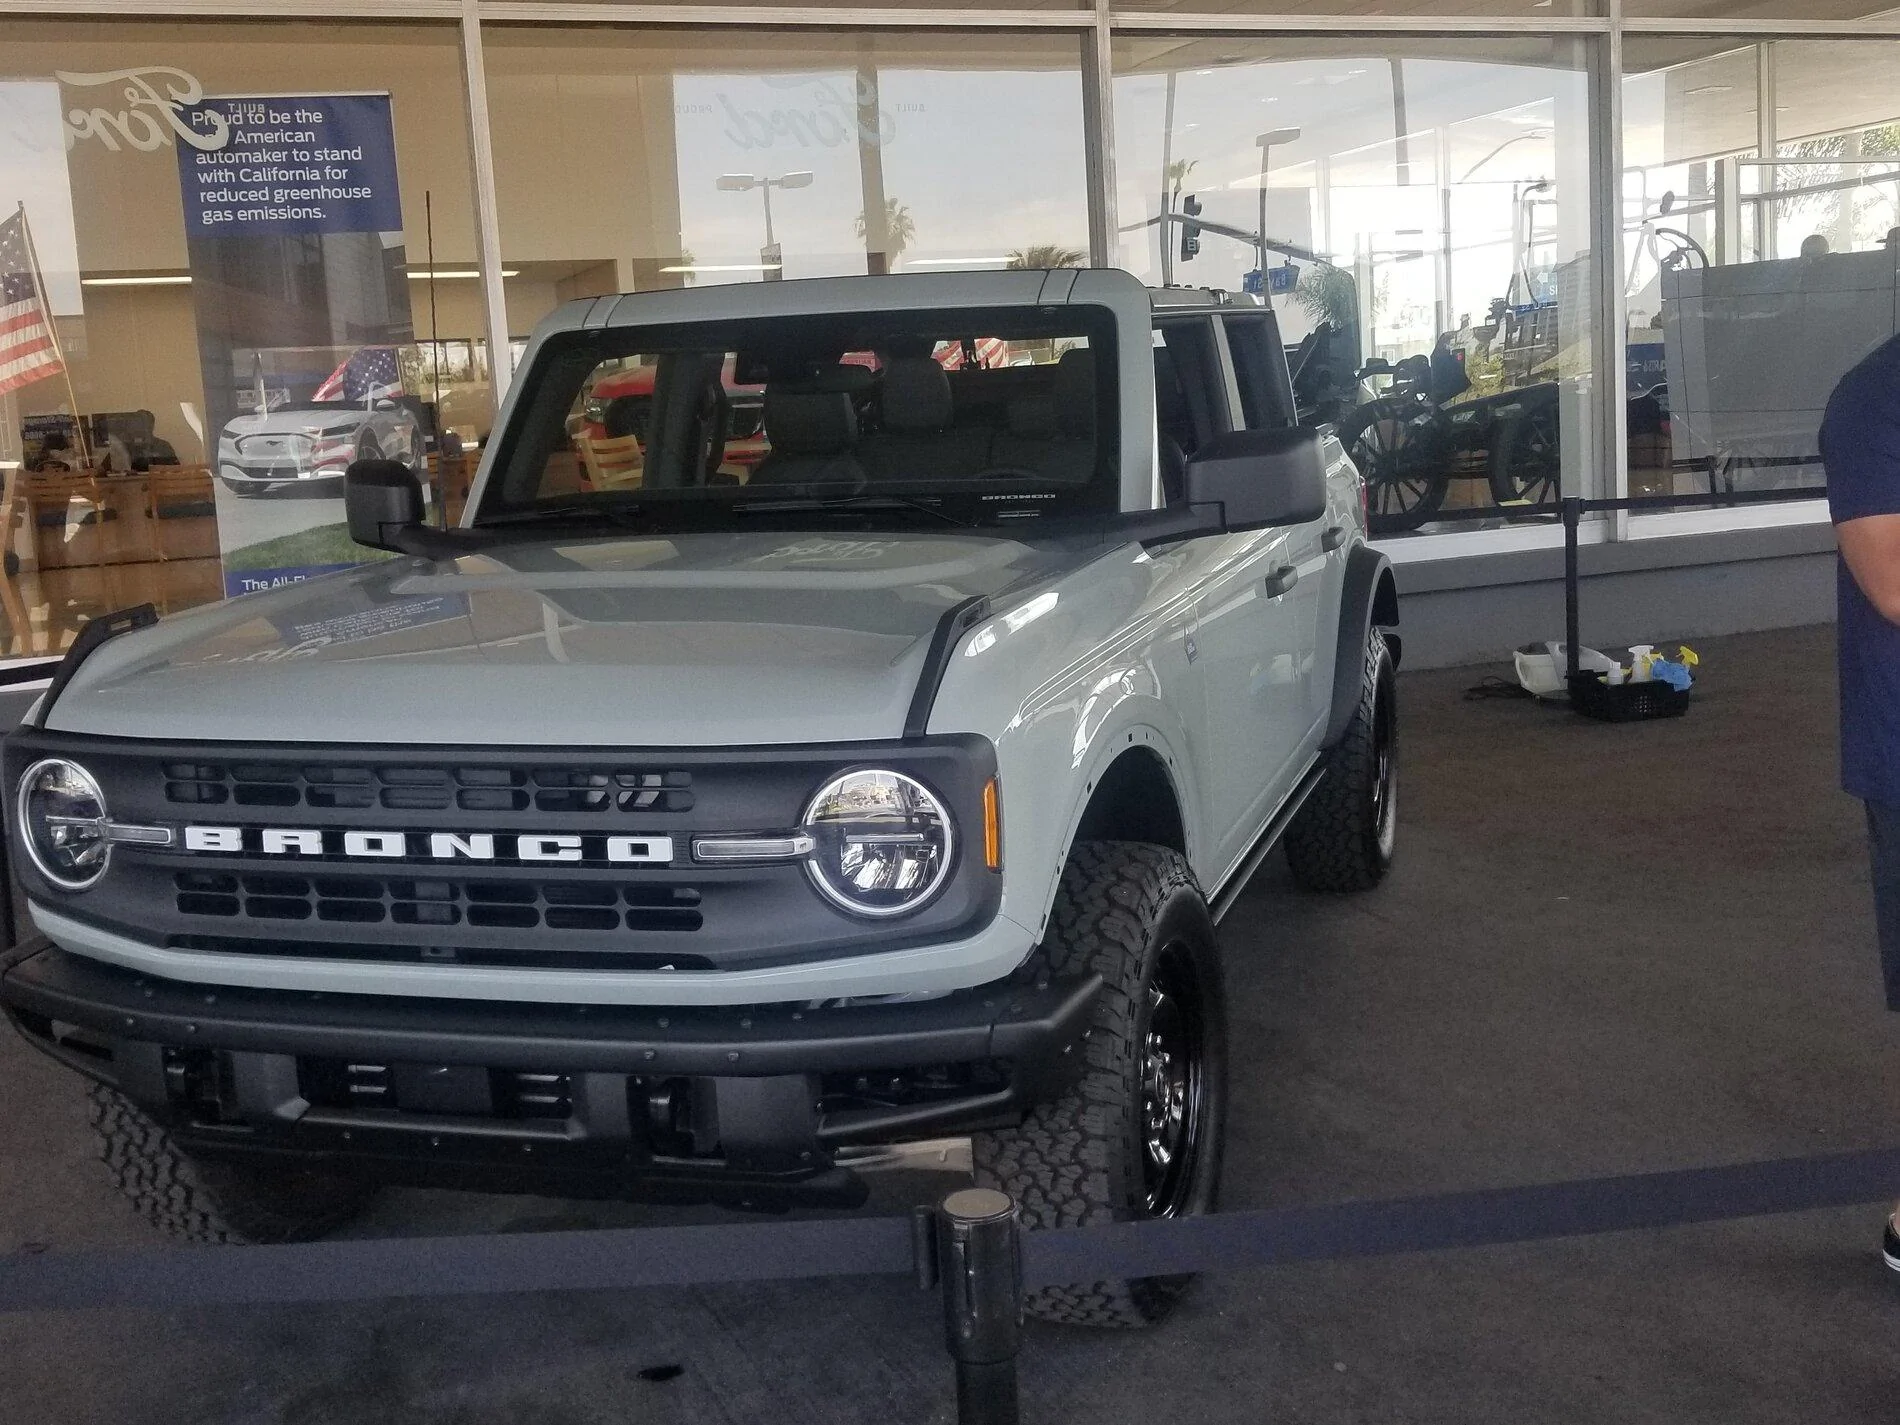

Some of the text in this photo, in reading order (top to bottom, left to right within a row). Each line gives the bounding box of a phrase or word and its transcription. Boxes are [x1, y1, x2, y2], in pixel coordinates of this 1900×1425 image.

[247, 110, 266, 124] to
[269, 109, 291, 124] be
[295, 107, 323, 123] the
[234, 129, 315, 145] American
[196, 146, 362, 164] automaker to stand
[198, 165, 348, 184] with California for
[200, 185, 372, 204] reduced greenhouse
[202, 205, 327, 225] gas emissions.
[241, 578, 269, 591] The
[185, 825, 674, 863] BRONCO
